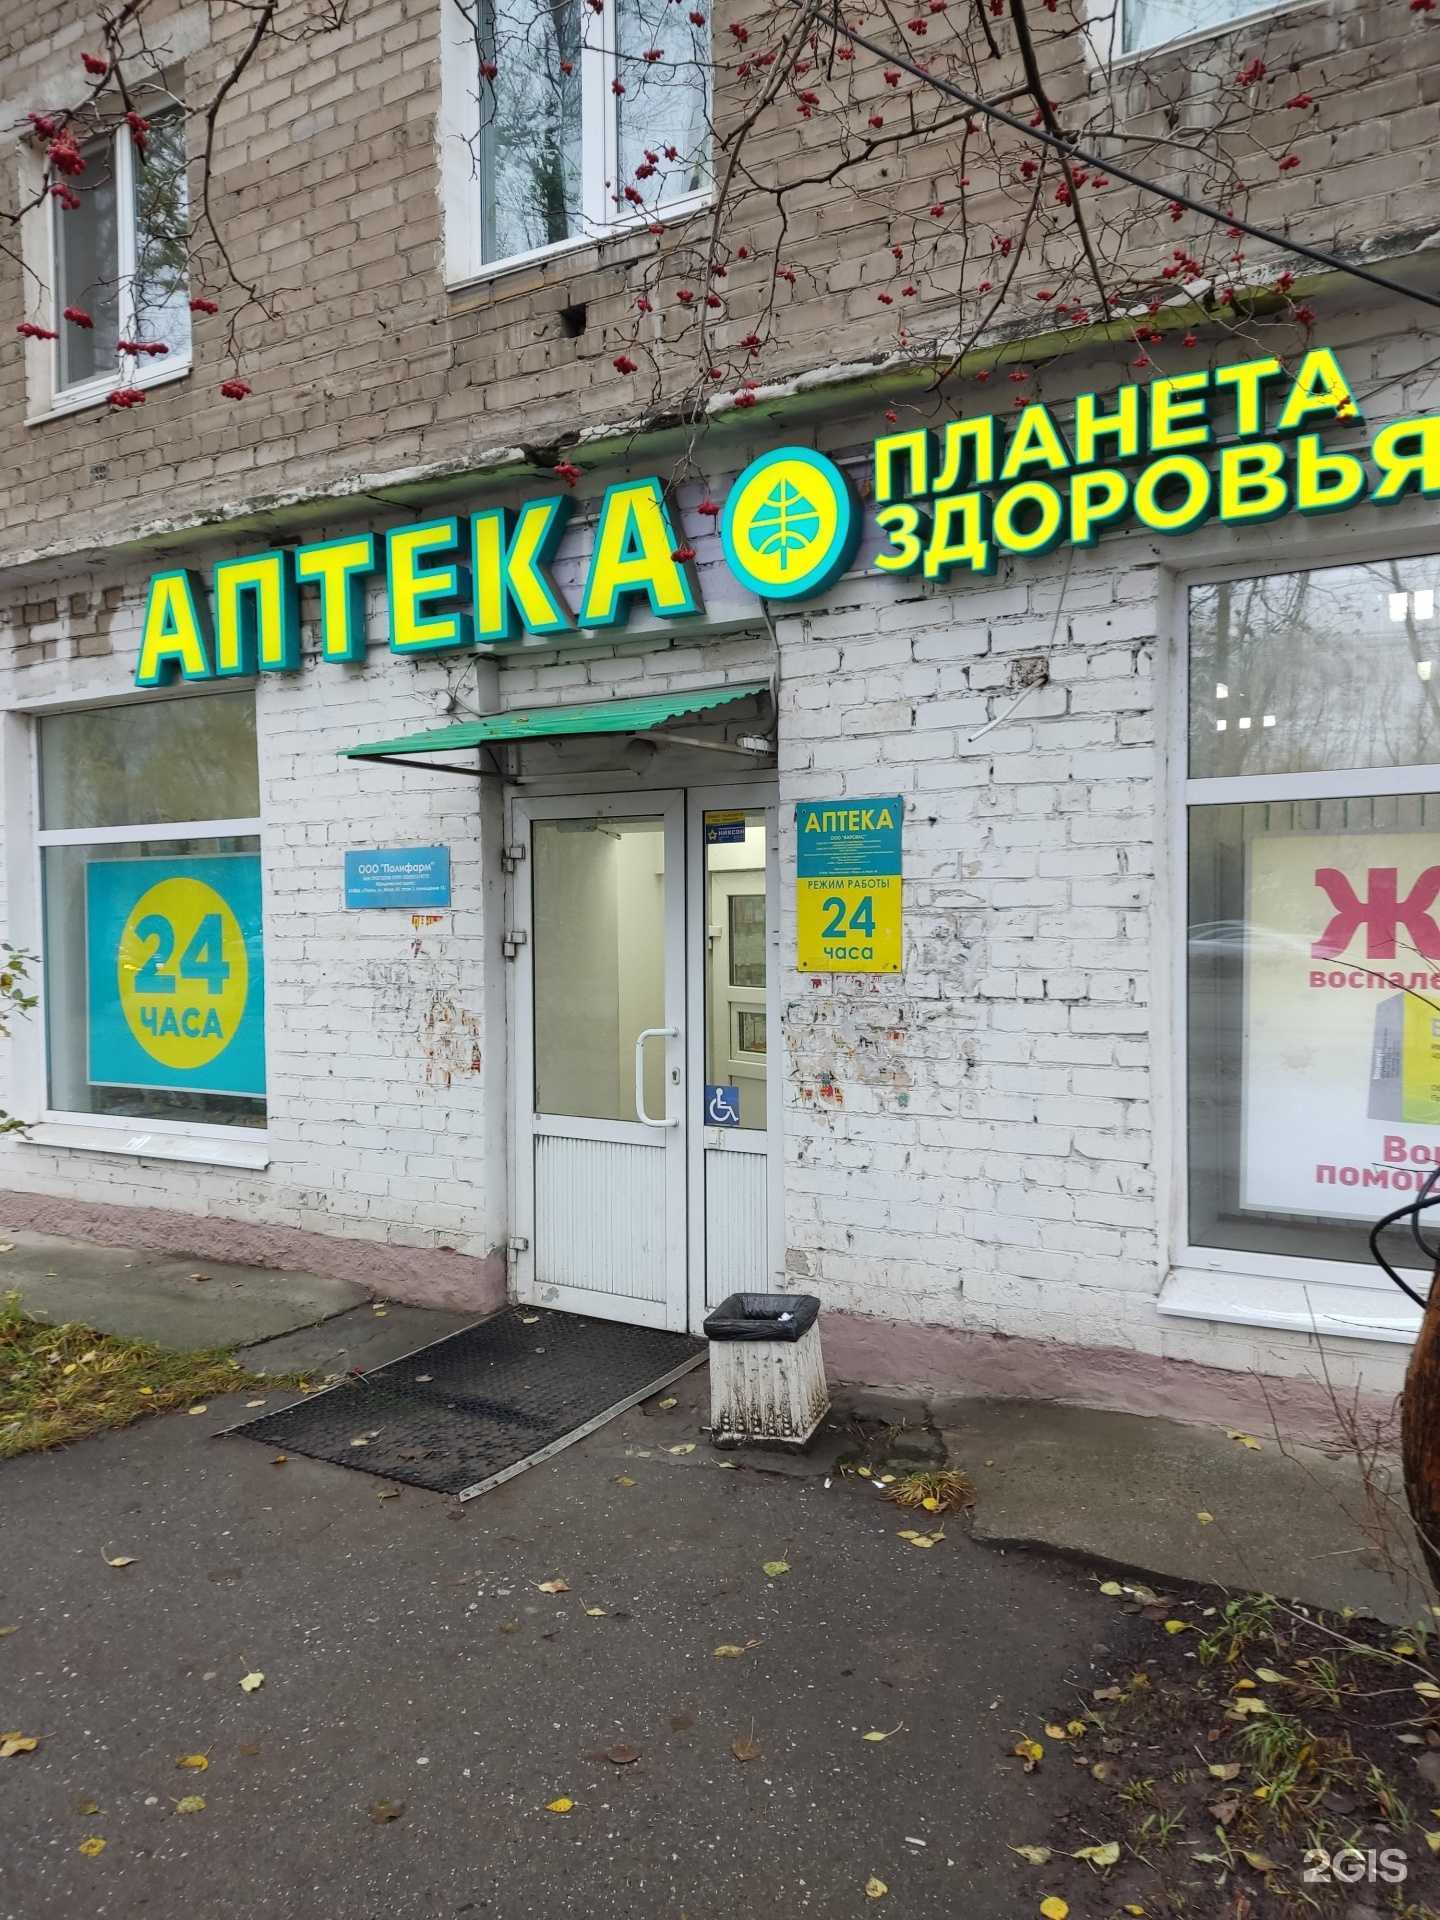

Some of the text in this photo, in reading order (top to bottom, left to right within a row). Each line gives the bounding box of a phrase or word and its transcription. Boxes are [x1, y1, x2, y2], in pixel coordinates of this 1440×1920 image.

[874, 347, 1364, 502] ПЛАНЕТА
[873, 416, 1440, 579] ЗДОРОВЬЯ
[135, 476, 703, 687] АПТЕКА
[805, 808, 894, 833] АПТЕКА
[358, 864, 379, 874] ООО
[808, 878, 890, 889] РЕЖИМ РАБОТЫ
[821, 895, 876, 938] 24
[133, 912, 230, 995] 24
[823, 946, 873, 960] часа
[139, 1006, 224, 1039] ЧАСА
[1383, 1135, 1440, 1168] Во
